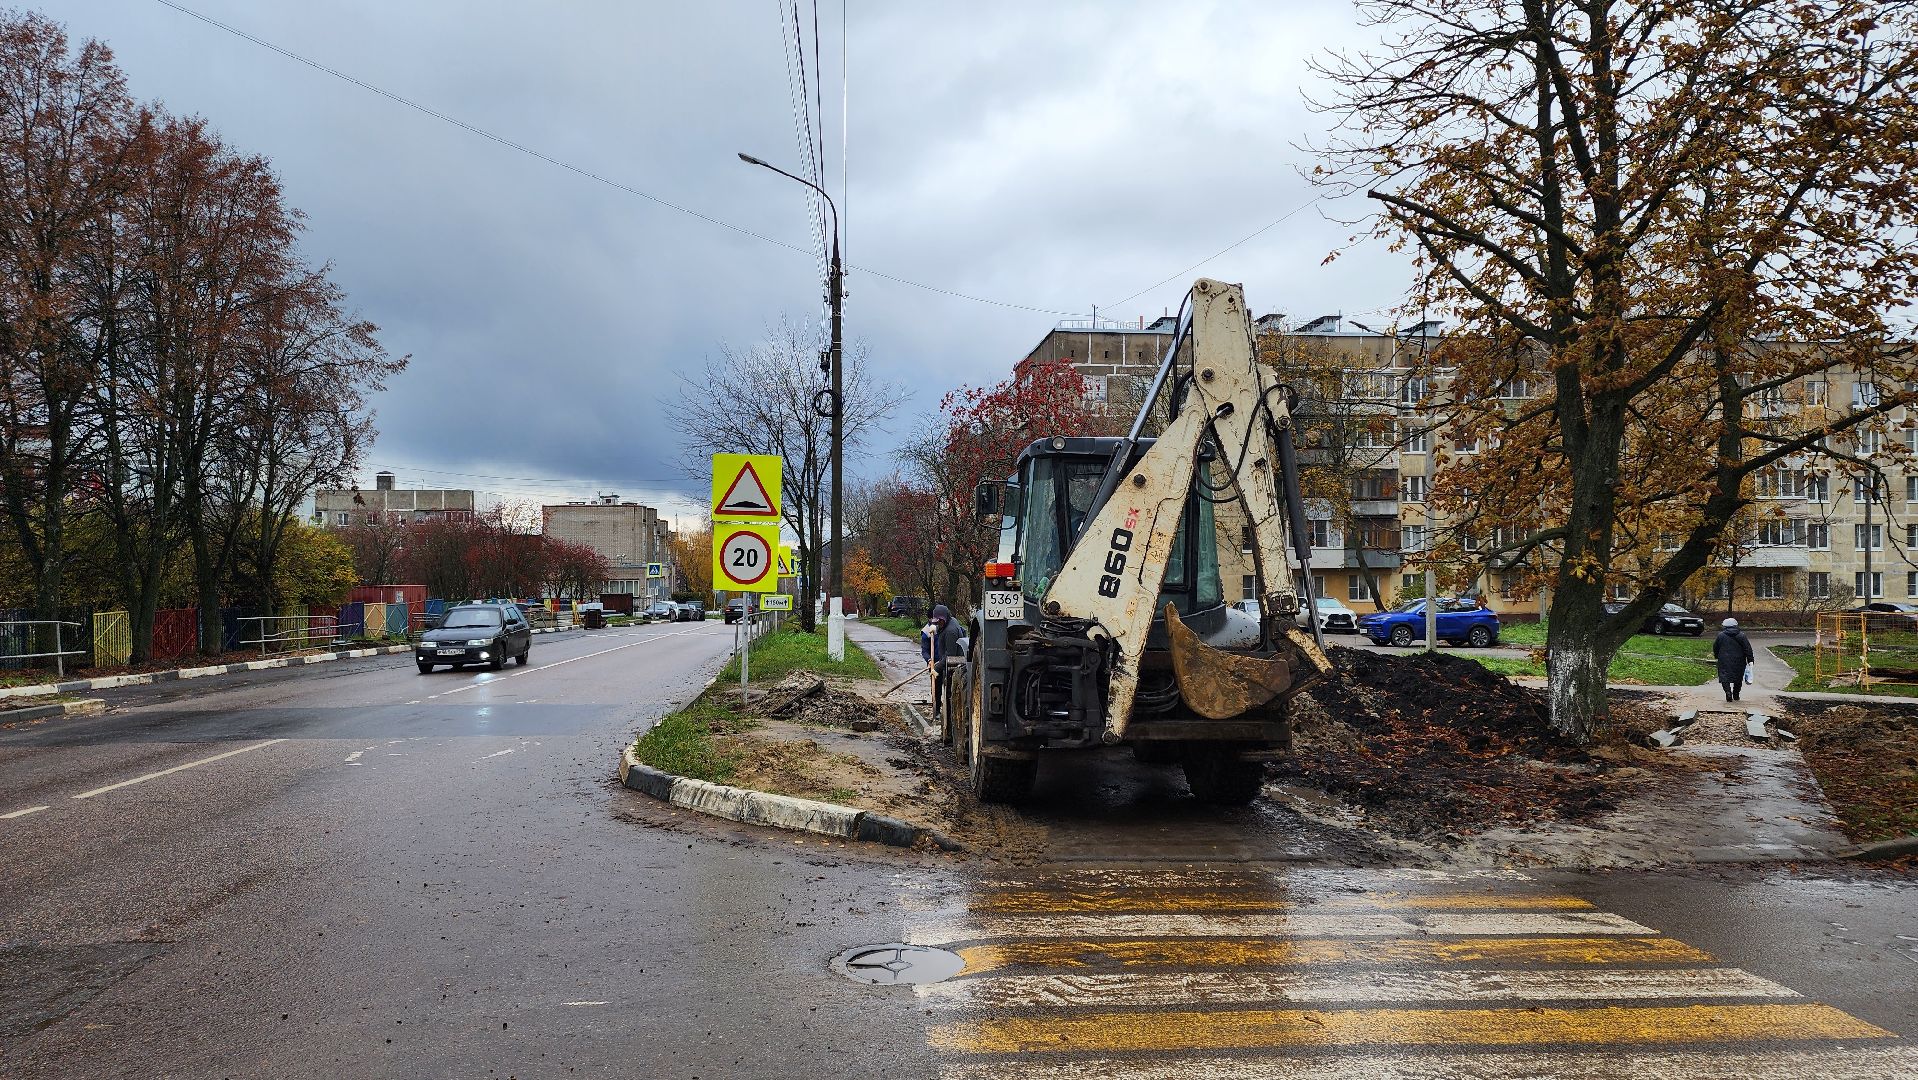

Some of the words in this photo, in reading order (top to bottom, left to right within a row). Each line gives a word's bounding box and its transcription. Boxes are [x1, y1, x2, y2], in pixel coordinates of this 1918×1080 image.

[733, 548, 758, 567] 20
[1098, 527, 1134, 598] 860
[990, 593, 1019, 605] 5369
[1009, 609, 1021, 618] 50
